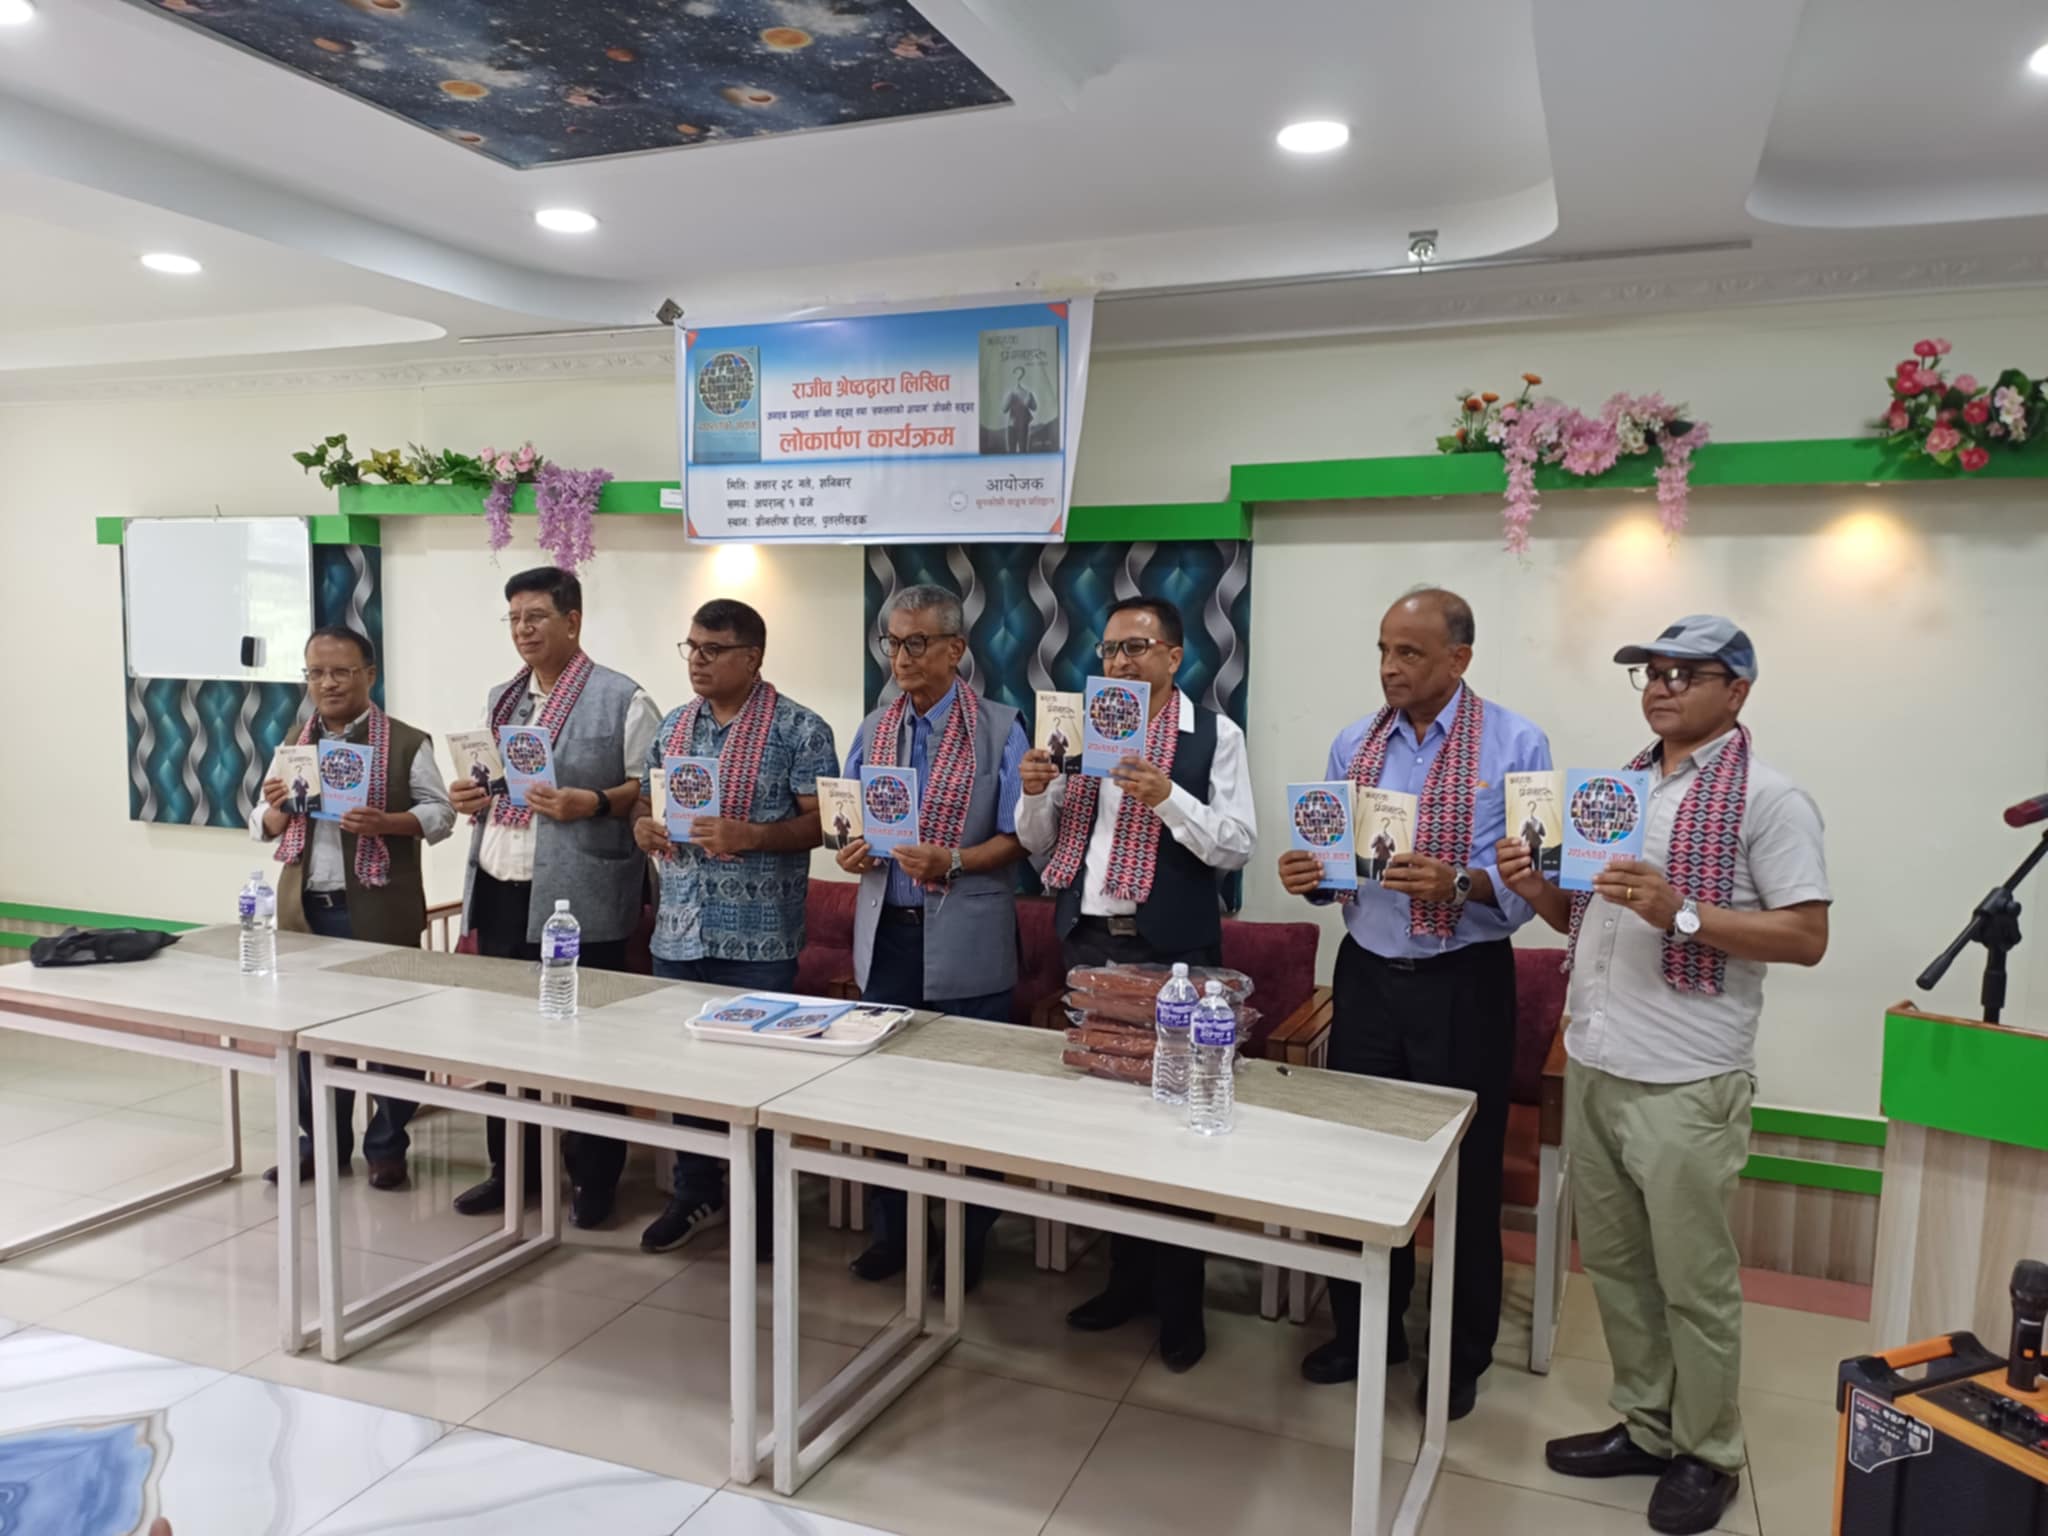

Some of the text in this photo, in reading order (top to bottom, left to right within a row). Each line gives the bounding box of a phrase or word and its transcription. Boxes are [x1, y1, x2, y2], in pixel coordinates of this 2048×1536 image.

[792, 377, 831, 400] राजीव
[900, 370, 951, 394] लिखित
[779, 423, 955, 453] लोकार्पण कार्यक्रम
[985, 473, 1045, 491] आयोजक
